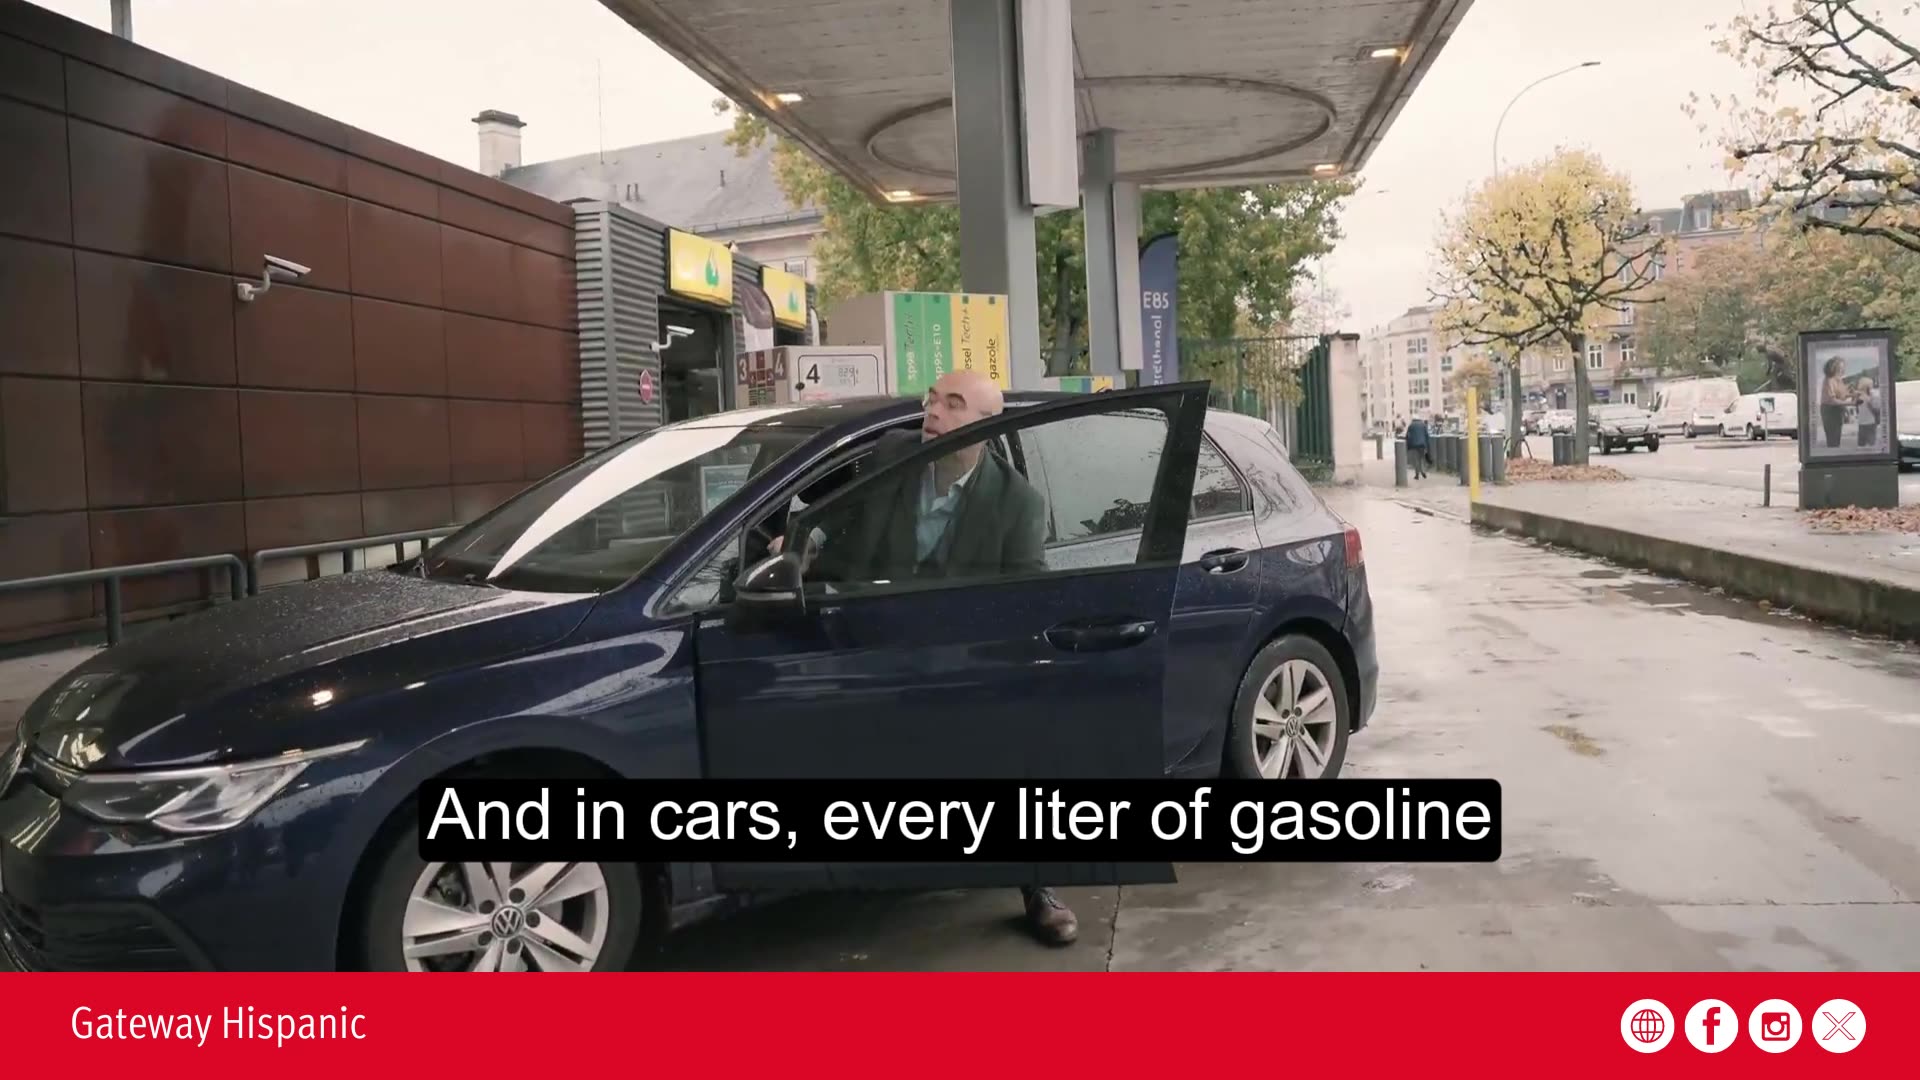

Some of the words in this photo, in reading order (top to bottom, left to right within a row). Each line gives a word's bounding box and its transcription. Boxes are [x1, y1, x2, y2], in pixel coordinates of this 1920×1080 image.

[1143, 291, 1169, 309] E85
[739, 358, 748, 381] 3
[775, 352, 785, 377] 4
[986, 338, 1000, 380] gazole
[806, 363, 821, 384] 4
